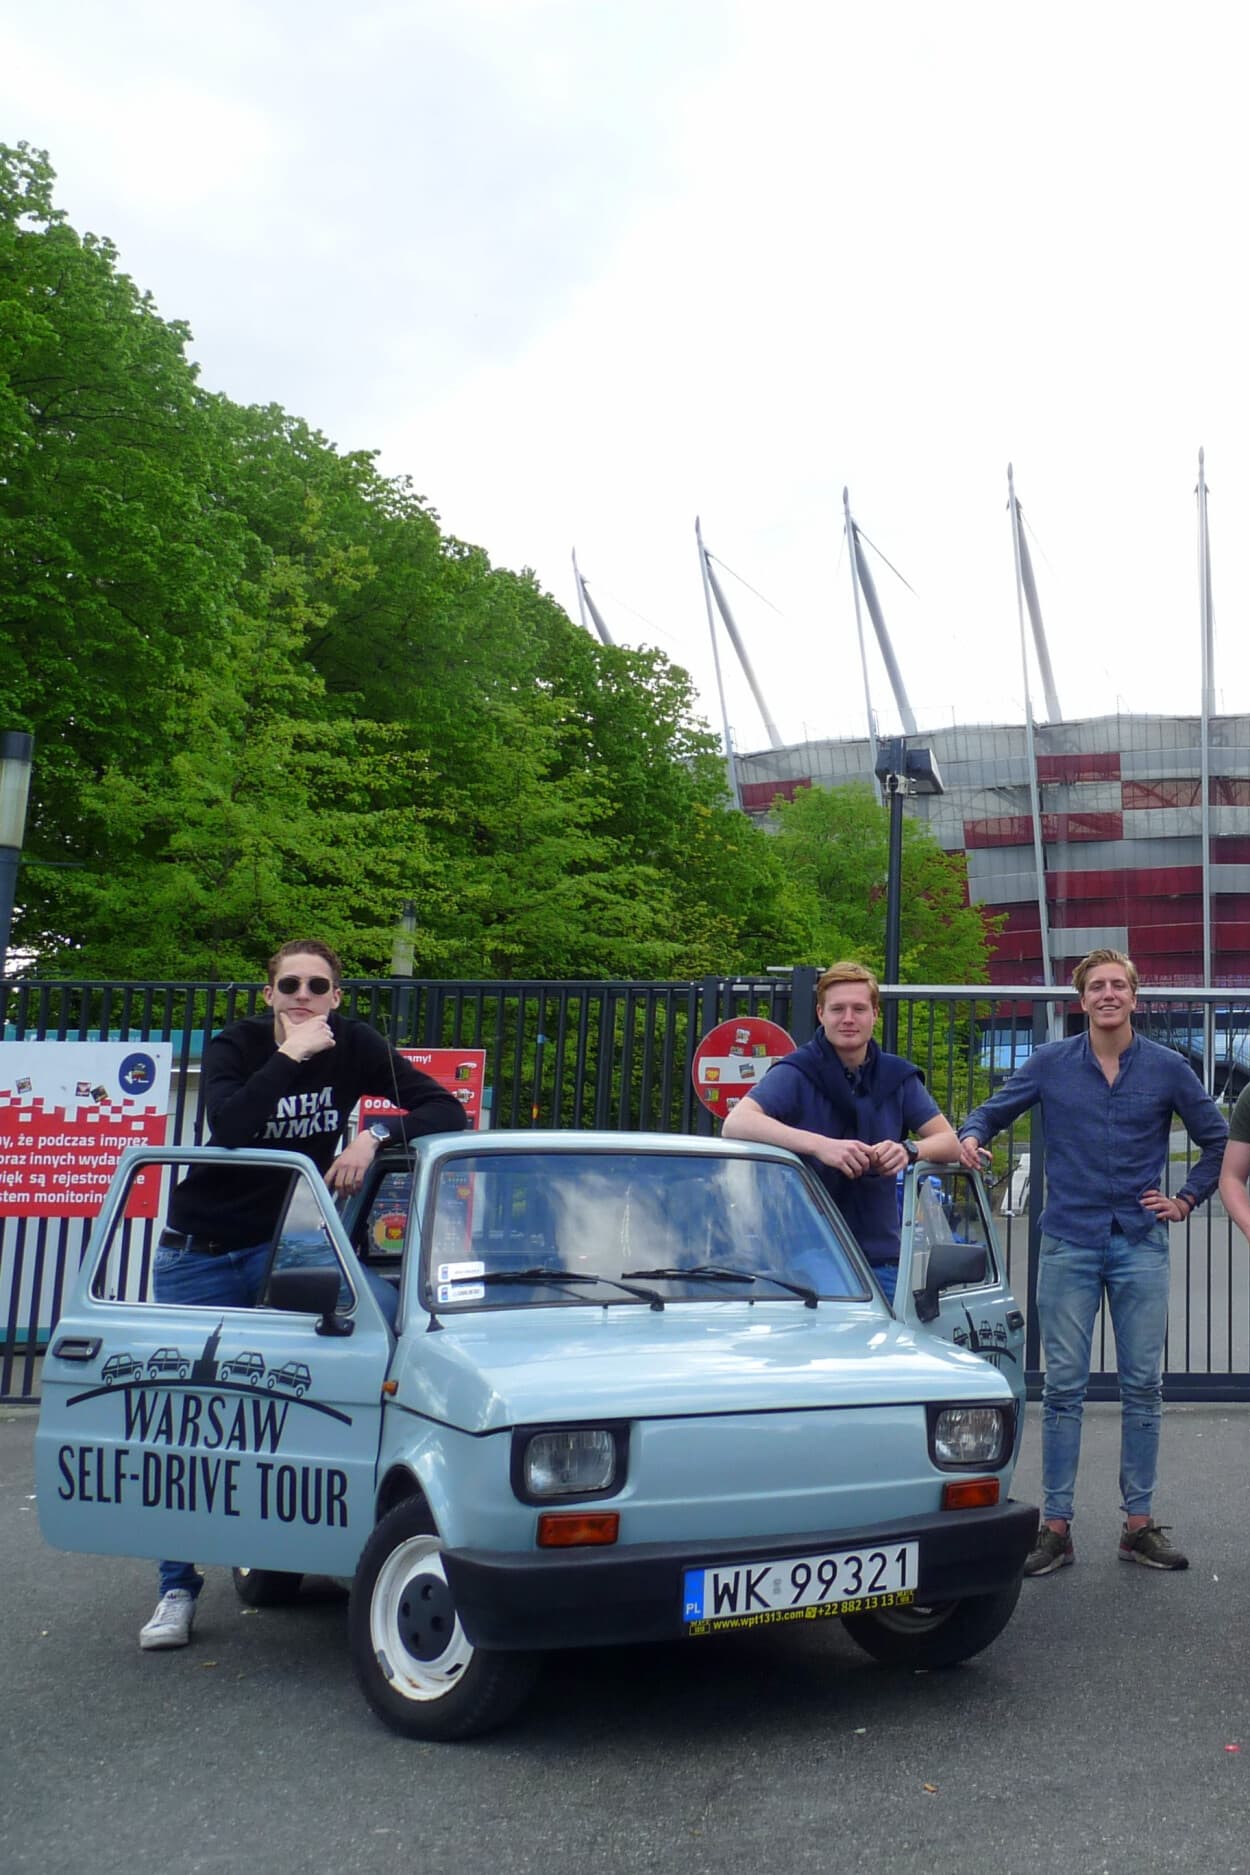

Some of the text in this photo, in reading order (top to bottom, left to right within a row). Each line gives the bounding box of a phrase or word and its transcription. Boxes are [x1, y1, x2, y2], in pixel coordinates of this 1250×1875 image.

[0, 1133, 149, 1150] y, że podczas imprez
[0, 1155, 26, 1165] oraz
[30, 1152, 76, 1168] innych
[29, 1173, 46, 1188] są
[123, 1388, 290, 1454] WARSAW
[58, 1445, 349, 1528] SELF-DRIVE TOUR
[712, 1547, 908, 1616] WK 99321
[685, 1602, 701, 1616] PL
[817, 1603, 839, 1616] +22
[840, 1599, 862, 1614] 882
[864, 1596, 879, 1610] 13
[881, 1593, 895, 1607] 13
